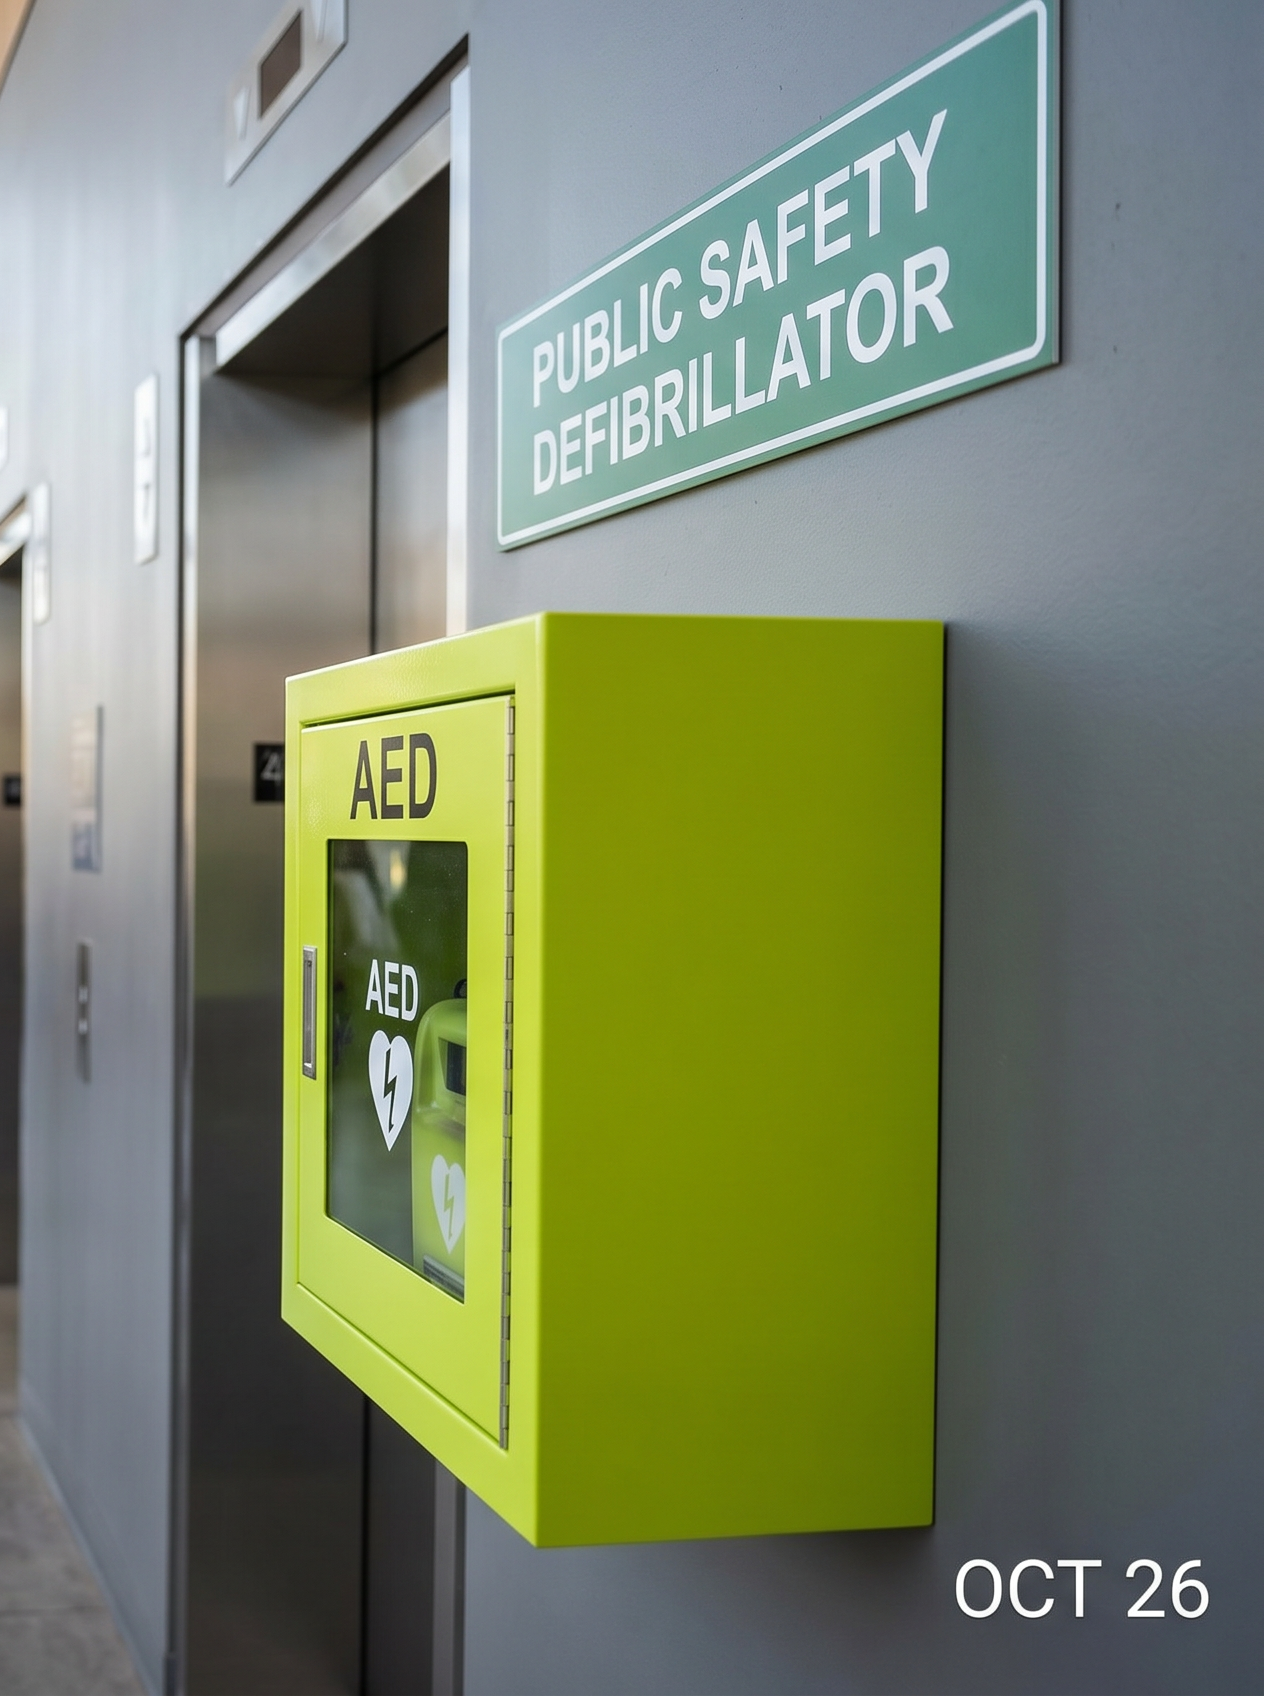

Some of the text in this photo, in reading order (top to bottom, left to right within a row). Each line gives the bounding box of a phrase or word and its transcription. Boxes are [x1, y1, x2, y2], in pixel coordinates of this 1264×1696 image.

[533, 109, 948, 408] PUBLIC SAFETY
[533, 246, 954, 495] DEFIBRILLATOR
[350, 733, 437, 819] AED
[366, 958, 419, 1022] AED
